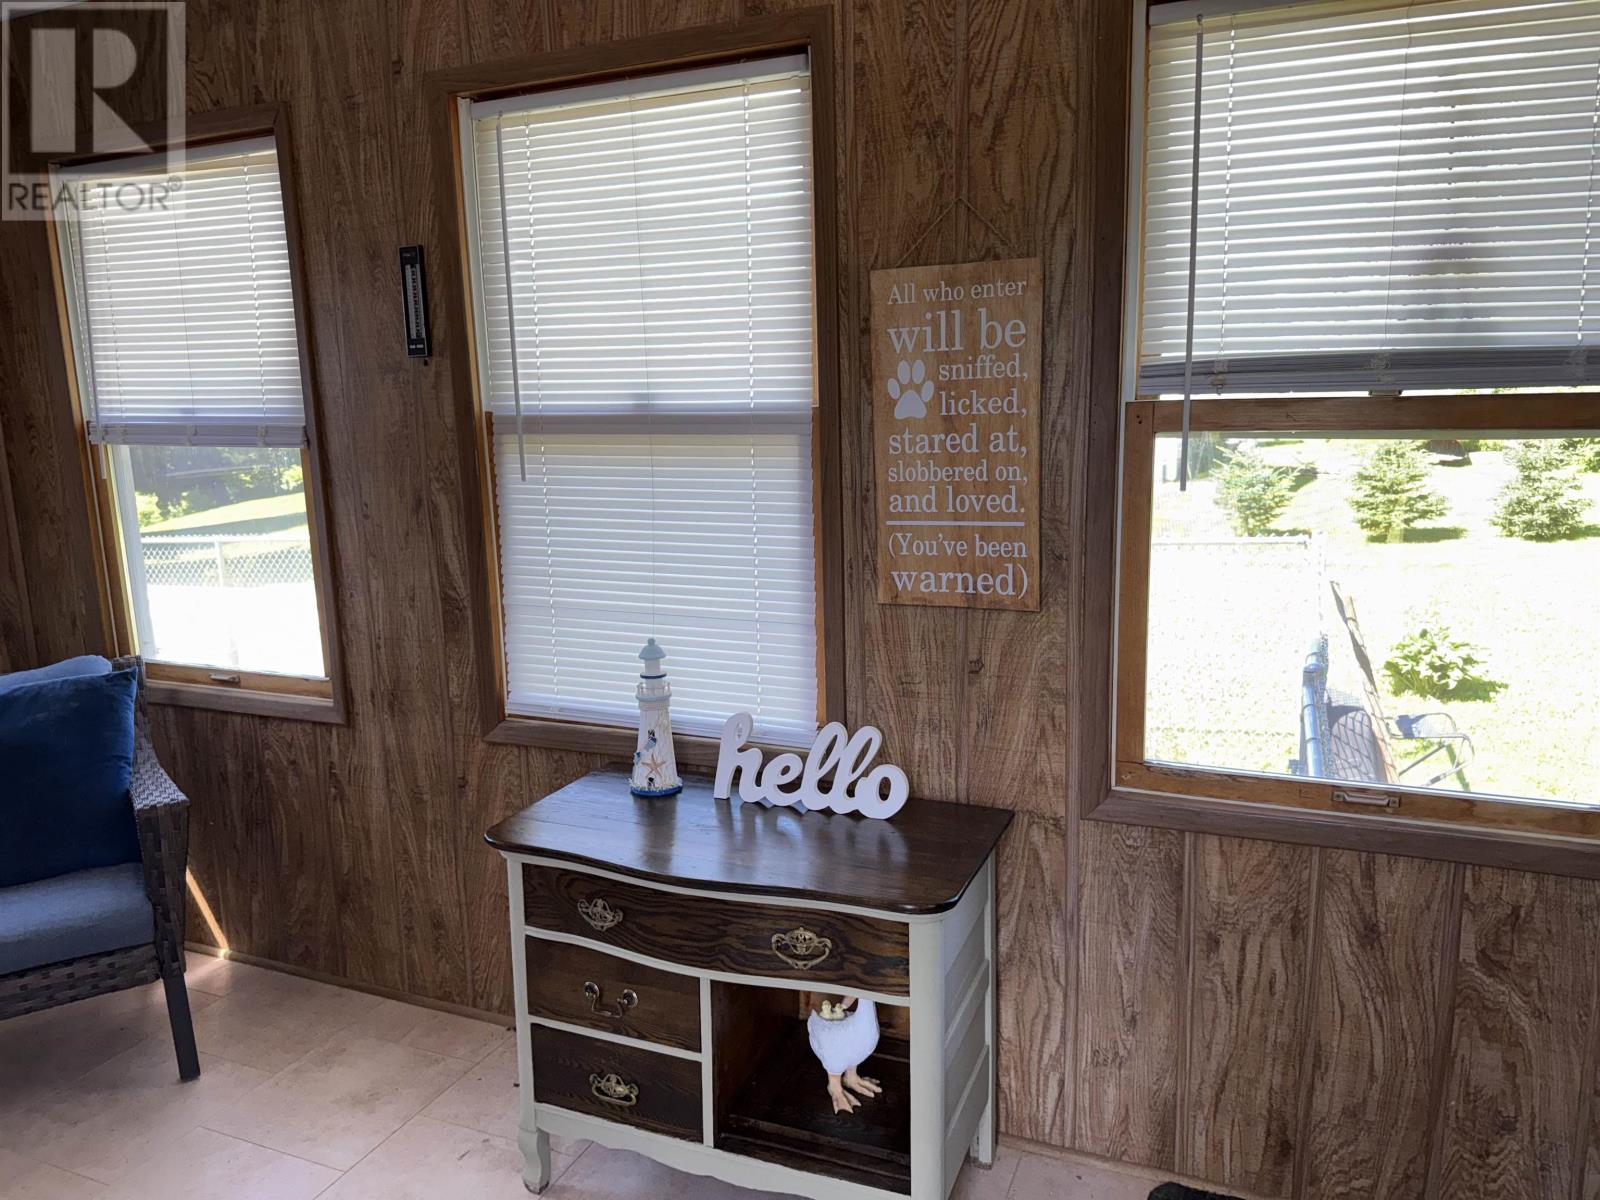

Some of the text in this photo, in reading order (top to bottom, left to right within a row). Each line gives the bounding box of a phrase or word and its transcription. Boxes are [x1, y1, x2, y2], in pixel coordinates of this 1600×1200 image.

[887, 279, 1026, 305] All who enter
[887, 308, 1026, 353] will be
[938, 353, 1029, 381] sniffed,
[939, 388, 1028, 417] licked,
[889, 423, 1027, 458] stared at,
[888, 459, 1028, 485] slobbered on,
[889, 485, 1025, 513] and loved.
[975, 534, 1028, 558] been
[891, 563, 1028, 600] warned)
[713, 711, 910, 820] hello
